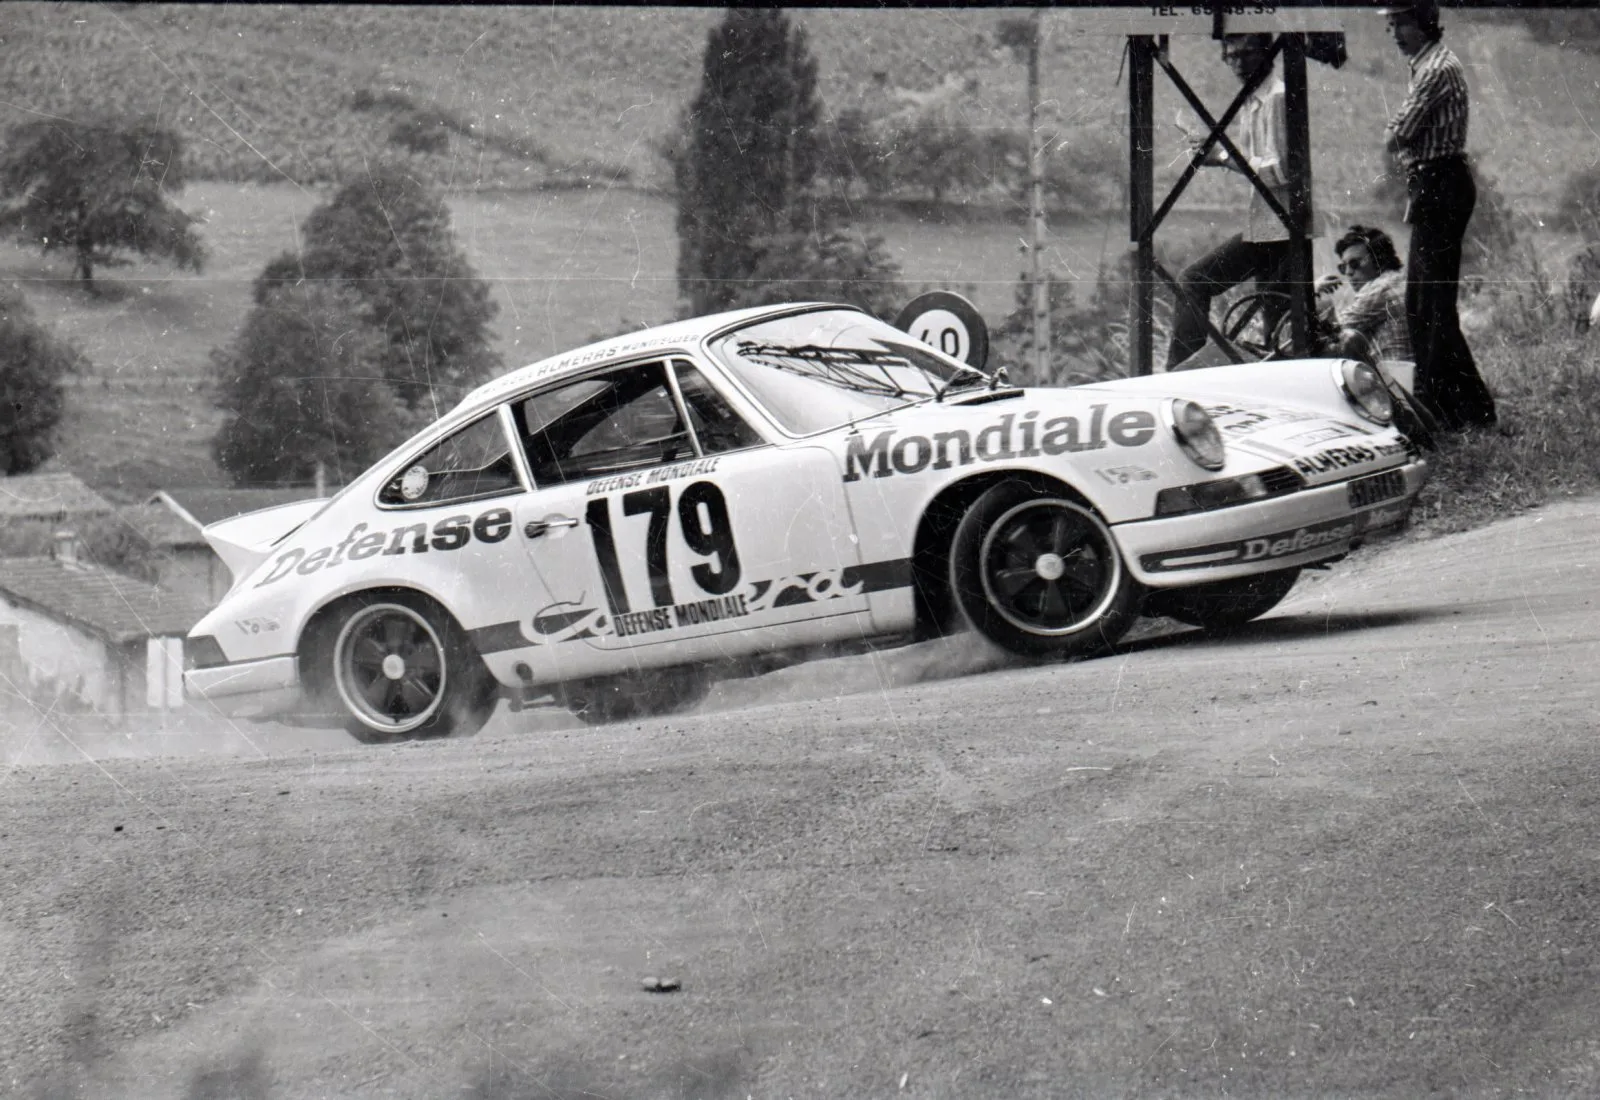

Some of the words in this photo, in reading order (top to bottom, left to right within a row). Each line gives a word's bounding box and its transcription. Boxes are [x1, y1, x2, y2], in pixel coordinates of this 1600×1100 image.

[1151, 6, 1185, 16] TEL.
[843, 404, 1156, 482] Mondiale
[586, 473, 642, 496] DEFENSE
[646, 457, 721, 483] MONDIALE
[254, 508, 512, 588] Defense
[585, 480, 742, 616] 179
[613, 607, 673, 637] DEFENSE
[674, 594, 750, 627] MONDIALE
